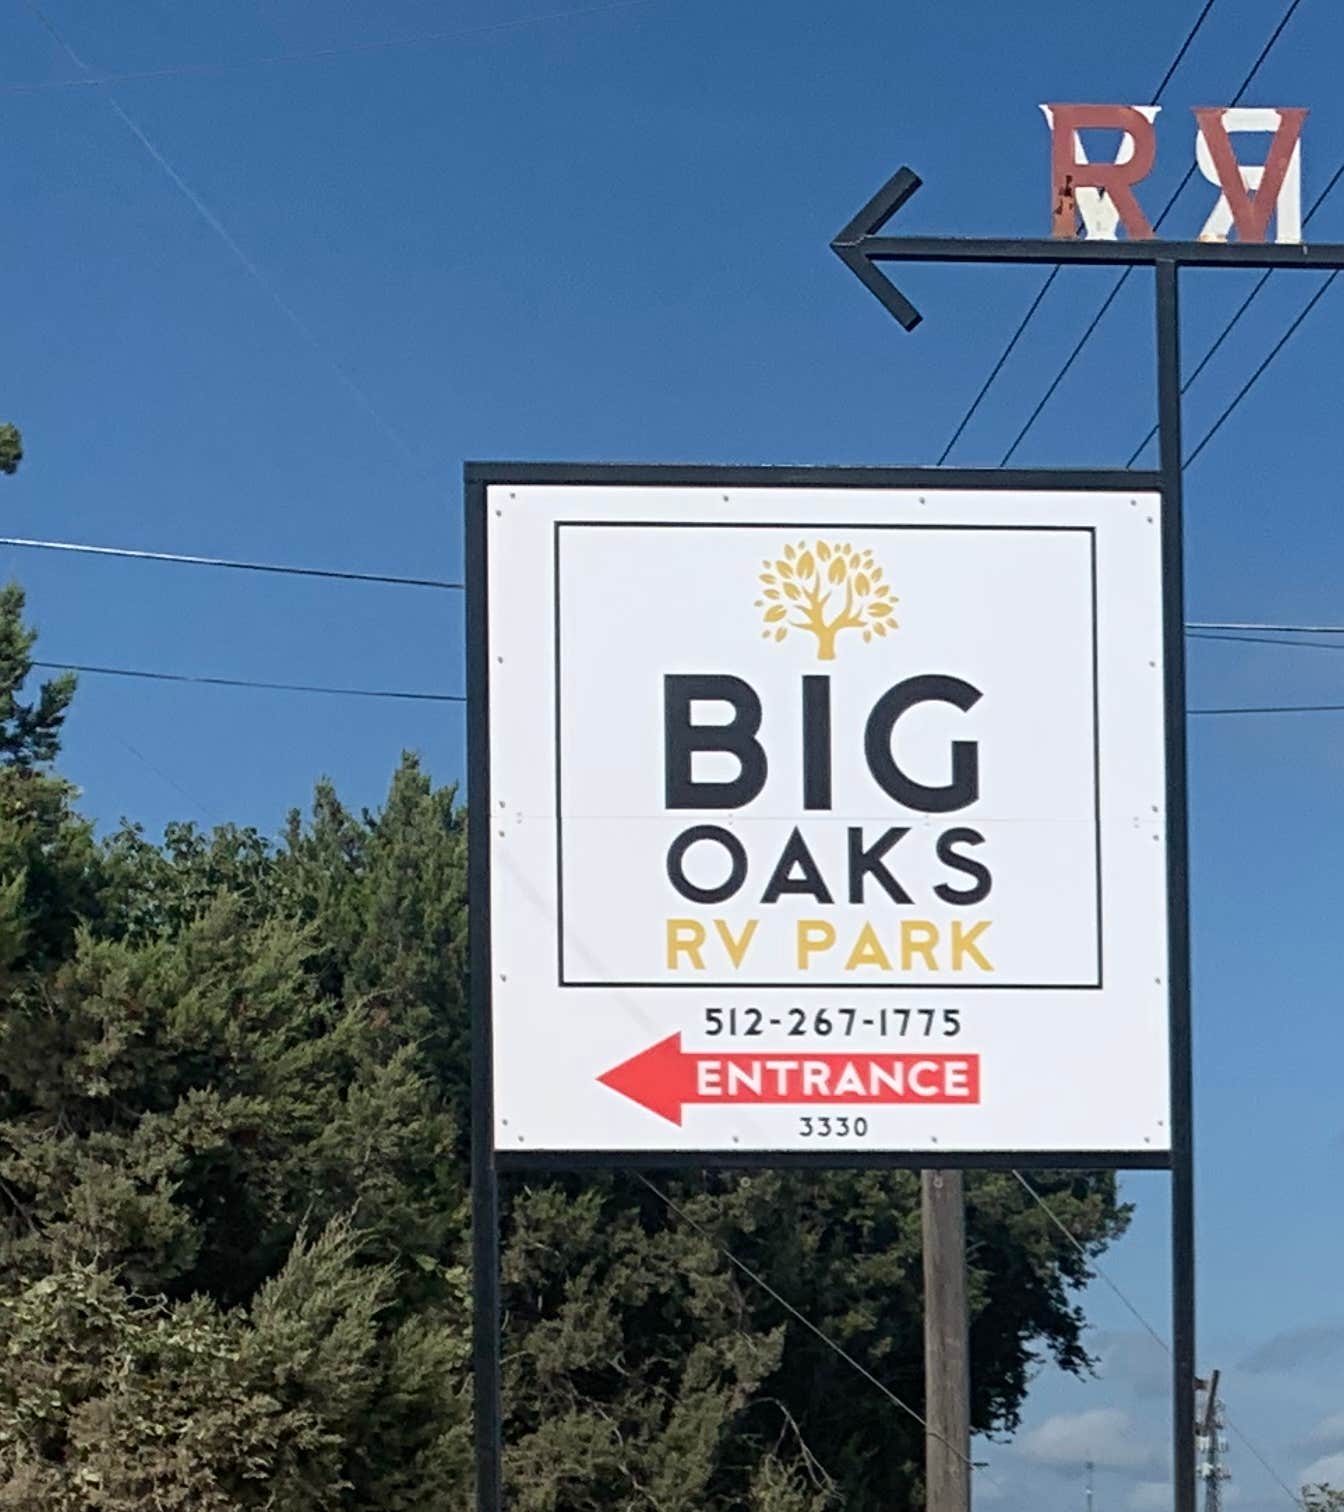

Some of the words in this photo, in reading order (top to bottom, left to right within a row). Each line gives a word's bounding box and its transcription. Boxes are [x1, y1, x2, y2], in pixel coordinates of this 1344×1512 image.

[664, 673, 984, 813] BIG
[666, 824, 993, 907] OAKS
[665, 918, 759, 971] RV
[796, 919, 994, 973] PARK
[704, 1007, 961, 1037] 512-267-1775
[697, 1060, 970, 1097] ENTRANCE
[799, 1116, 868, 1137] 3330
